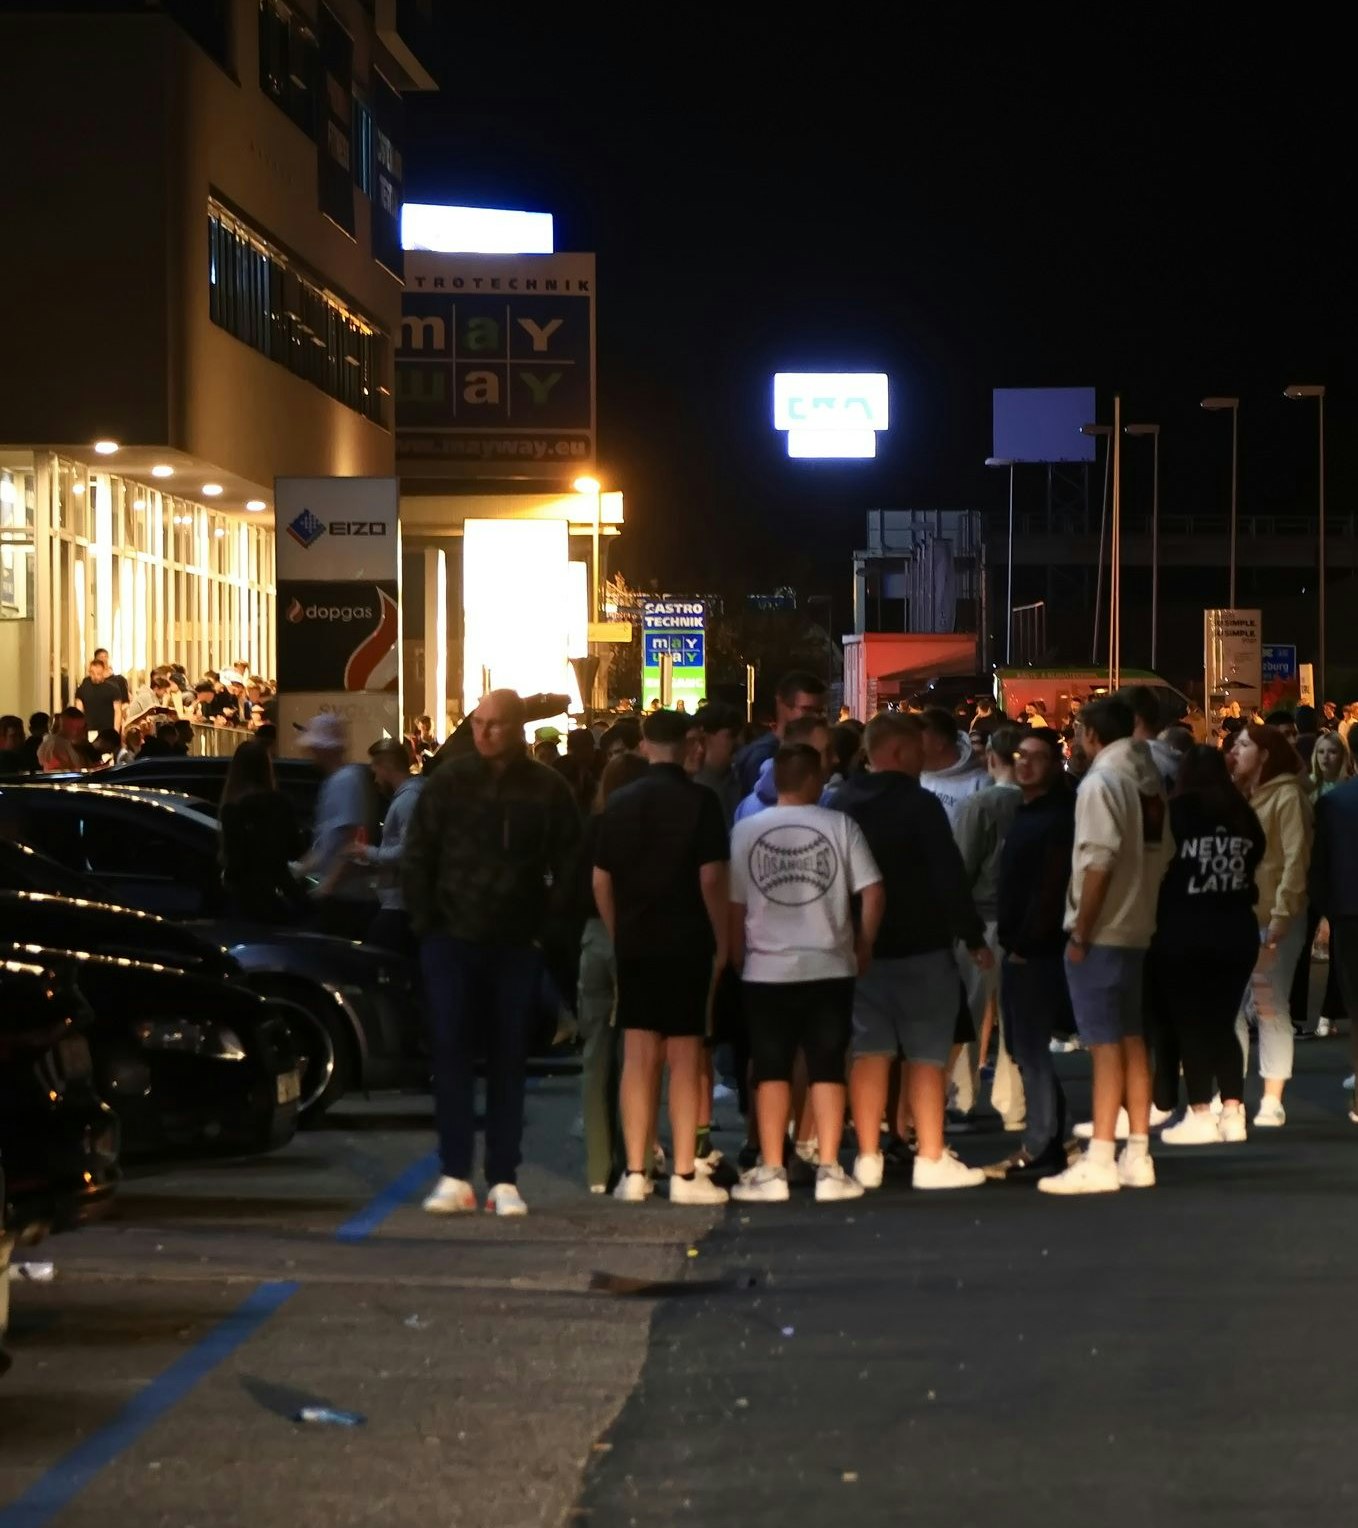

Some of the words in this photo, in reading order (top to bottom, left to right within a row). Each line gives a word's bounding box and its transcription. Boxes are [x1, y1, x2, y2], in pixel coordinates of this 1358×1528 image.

[329, 521, 387, 536] EIZO
[305, 605, 373, 622] dopgas
[645, 616, 704, 628] TECHNIK
[1200, 856, 1245, 875] TOO
